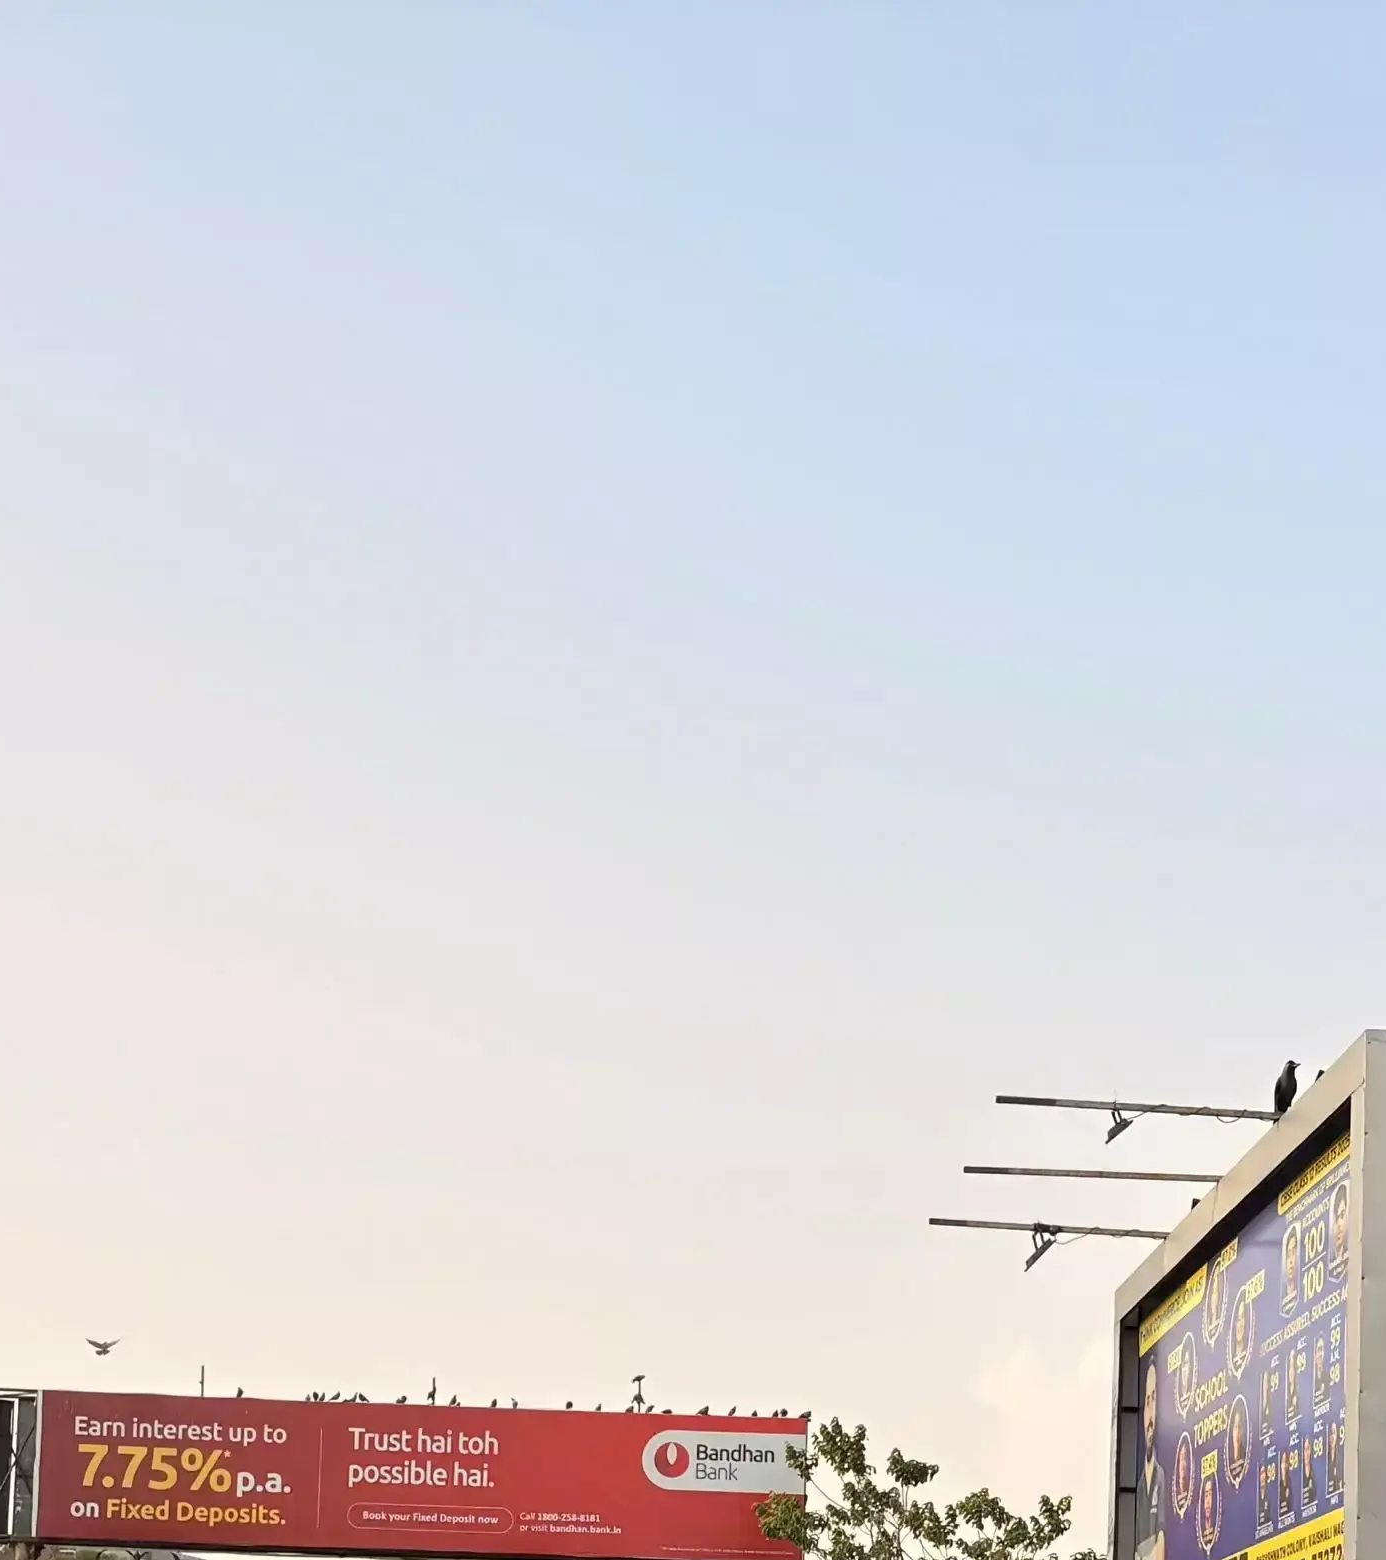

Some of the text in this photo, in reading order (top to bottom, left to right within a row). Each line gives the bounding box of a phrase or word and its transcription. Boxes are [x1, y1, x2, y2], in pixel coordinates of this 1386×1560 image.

[1304, 1220, 1325, 1261] 100
[1303, 1260, 1324, 1302] 100
[1194, 1370, 1228, 1412] SCHOOL
[74, 1416, 288, 1446] Earn interest up to
[1194, 1405, 1228, 1448] TOPPERS
[349, 1427, 499, 1457] Trust hai toh
[695, 1443, 775, 1463] Bandhan
[236, 1470, 293, 1498] p.a.
[348, 1462, 495, 1489] possible hai.
[695, 1463, 739, 1482] Bank
[70, 1498, 287, 1527] on Fixed Deposits.
[362, 1511, 499, 1525] Book your Fixed Deposit now
[519, 1511, 536, 1521] Call
[519, 1524, 529, 1532] or
[530, 1523, 548, 1532] visit
